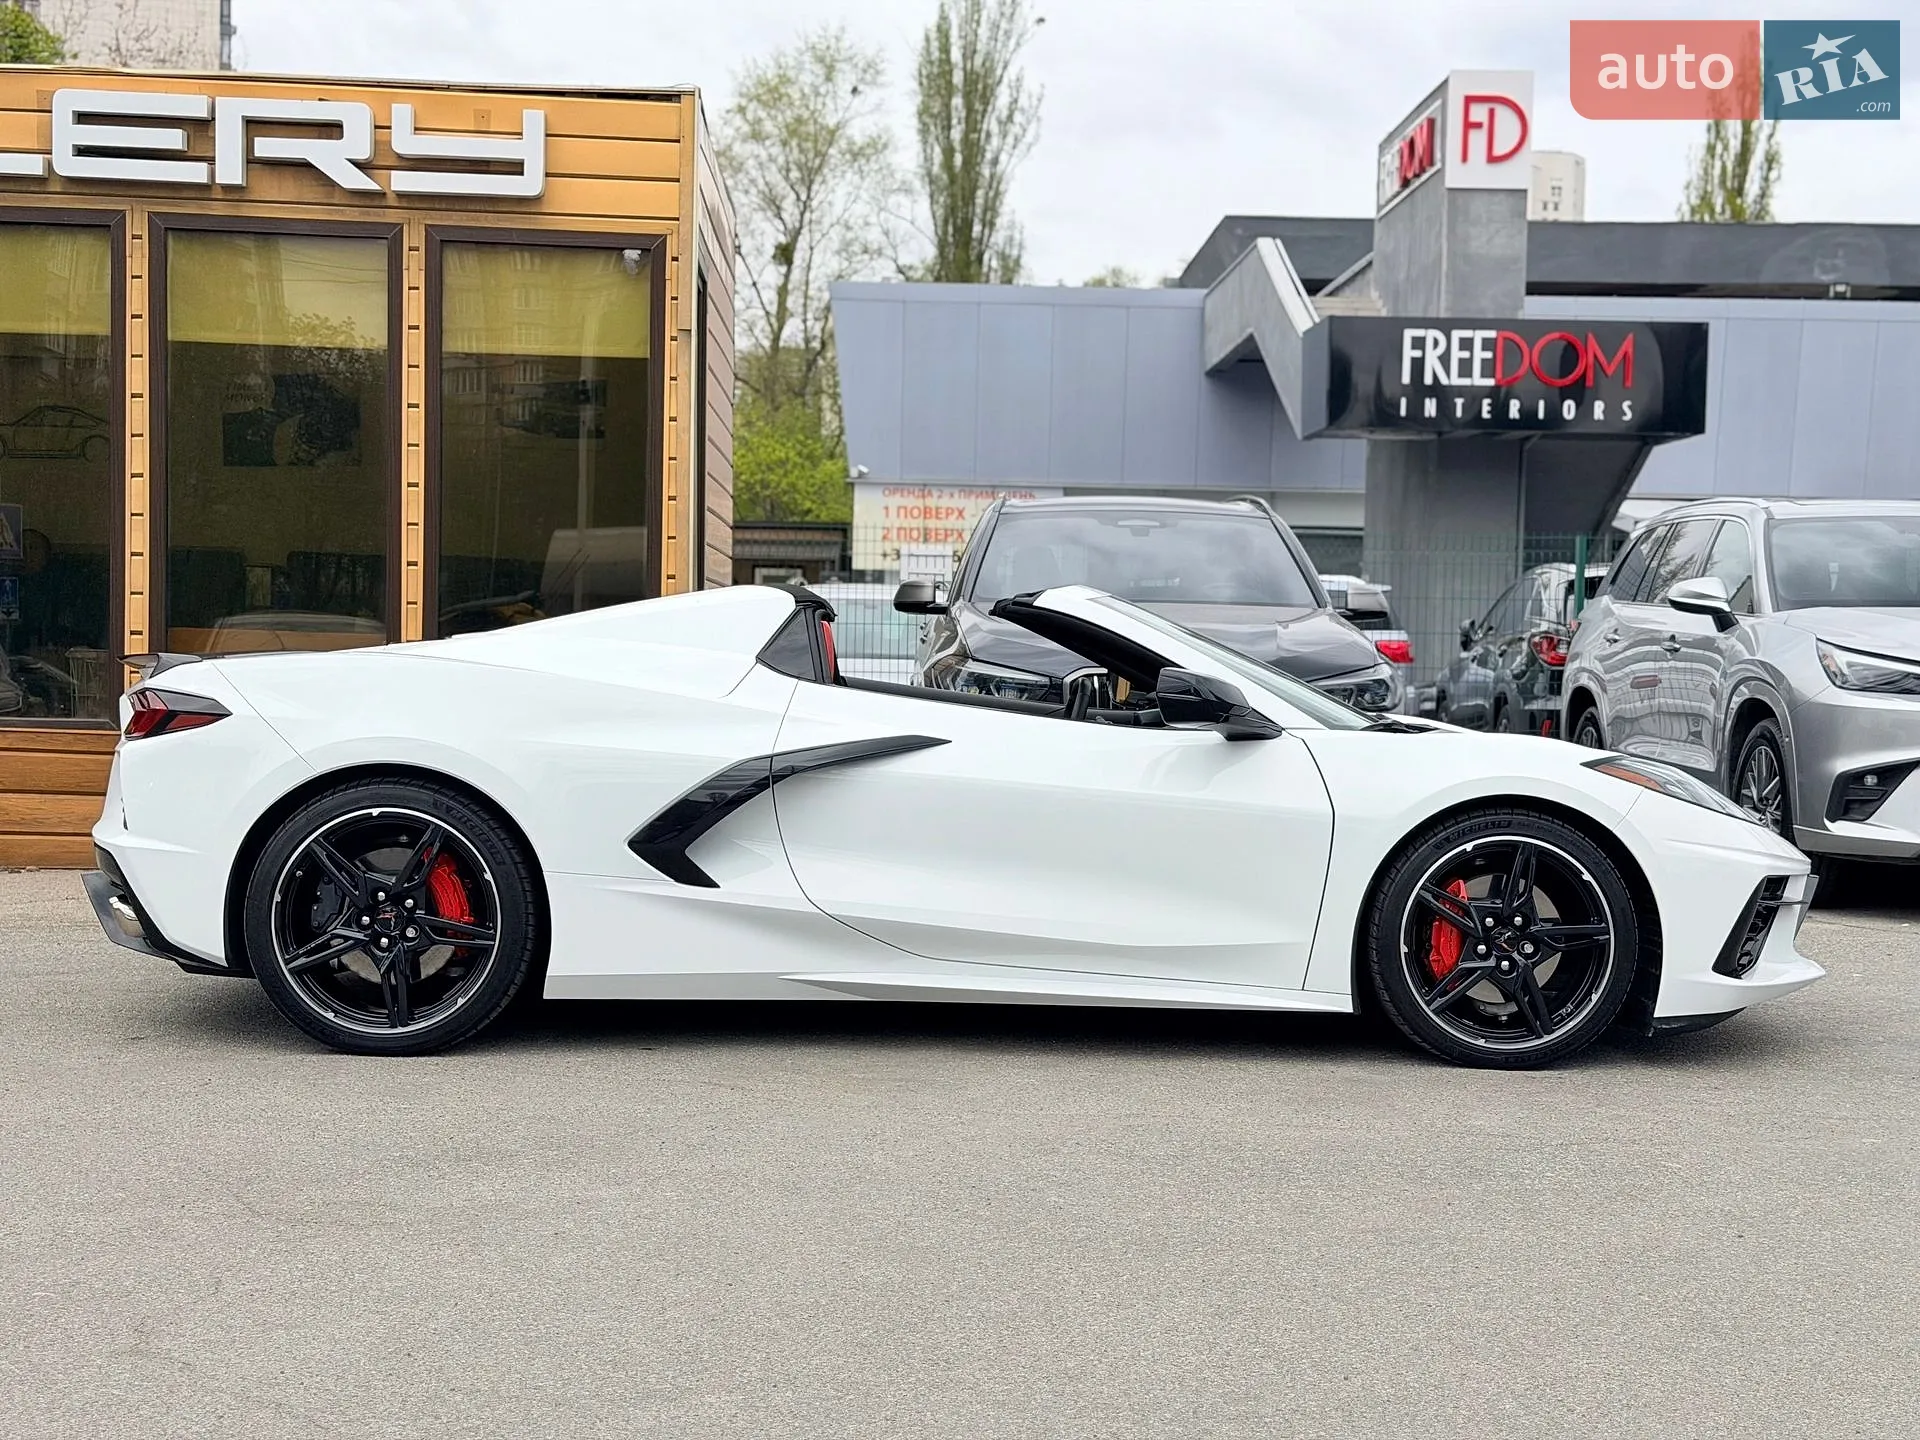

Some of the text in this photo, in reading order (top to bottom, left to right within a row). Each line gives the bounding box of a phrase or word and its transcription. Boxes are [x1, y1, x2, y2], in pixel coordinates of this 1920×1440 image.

[1460, 94, 1529, 164] FD
[1400, 328, 1636, 389] FREEDOM
[1399, 396, 1634, 421] INTERIORS
[882, 486, 934, 499] ОРЕНДА
[883, 505, 890, 519] 1
[896, 505, 966, 521] ПОВЕРХ
[882, 527, 965, 543] 2 ПОВЕРХ
